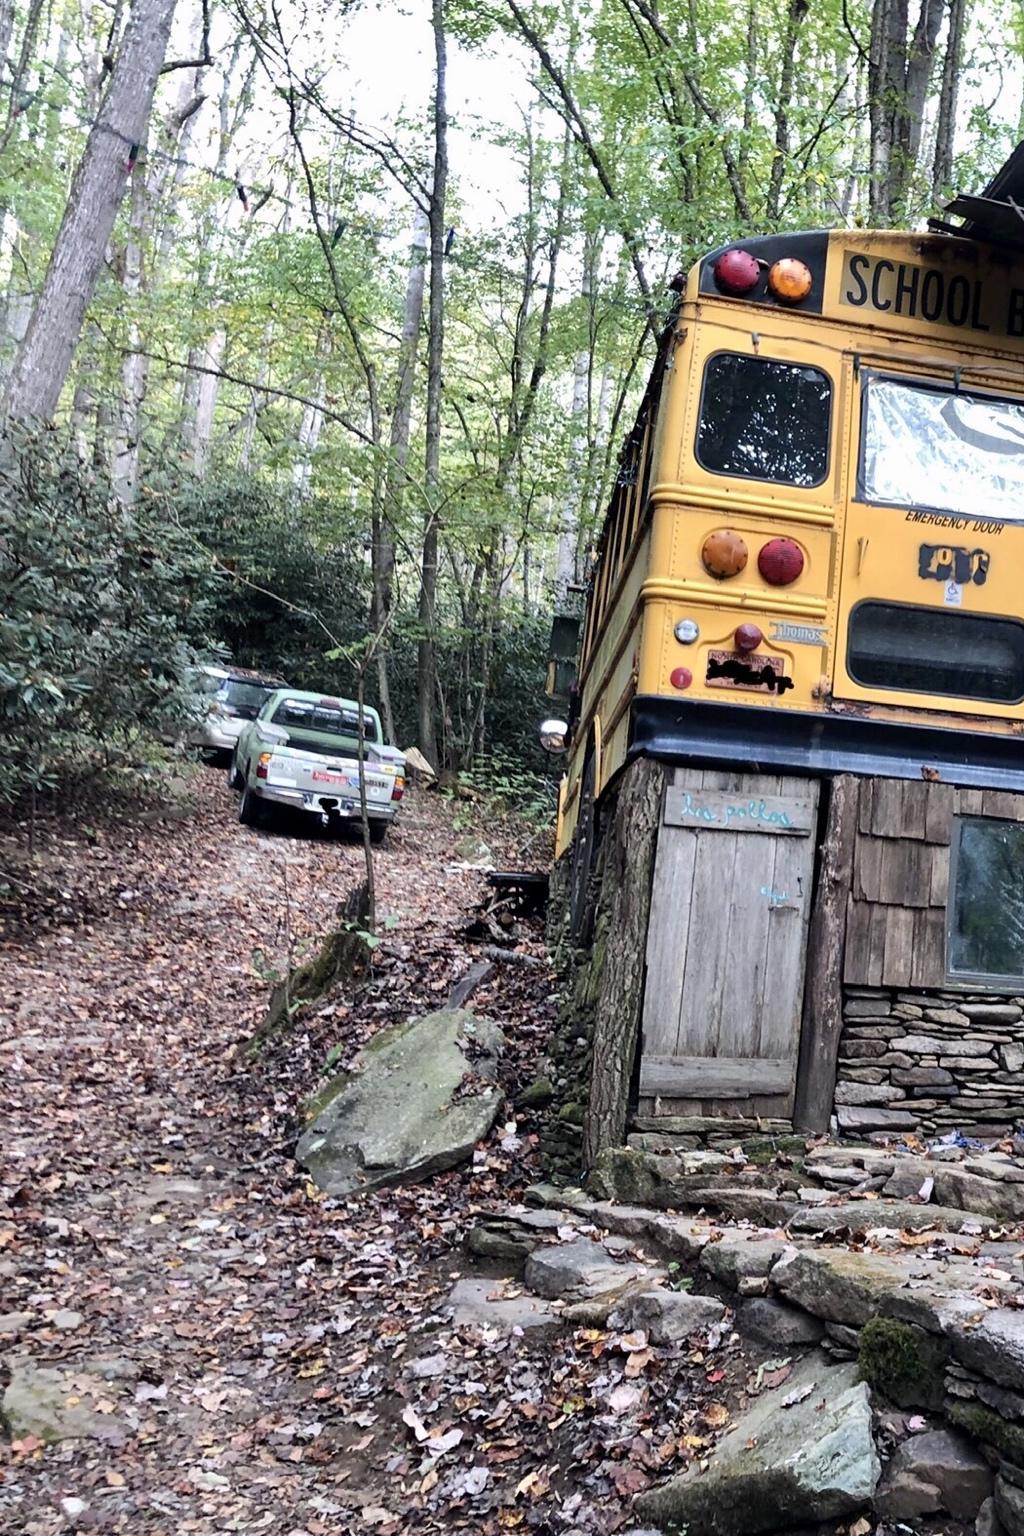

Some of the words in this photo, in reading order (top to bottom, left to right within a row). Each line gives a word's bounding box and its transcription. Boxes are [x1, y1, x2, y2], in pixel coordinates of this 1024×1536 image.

[846, 255, 990, 331] SCHOOL
[905, 510, 972, 530] EMERGENCY
[972, 520, 1005, 535] DOOR
[777, 622, 823, 643] Thomas
